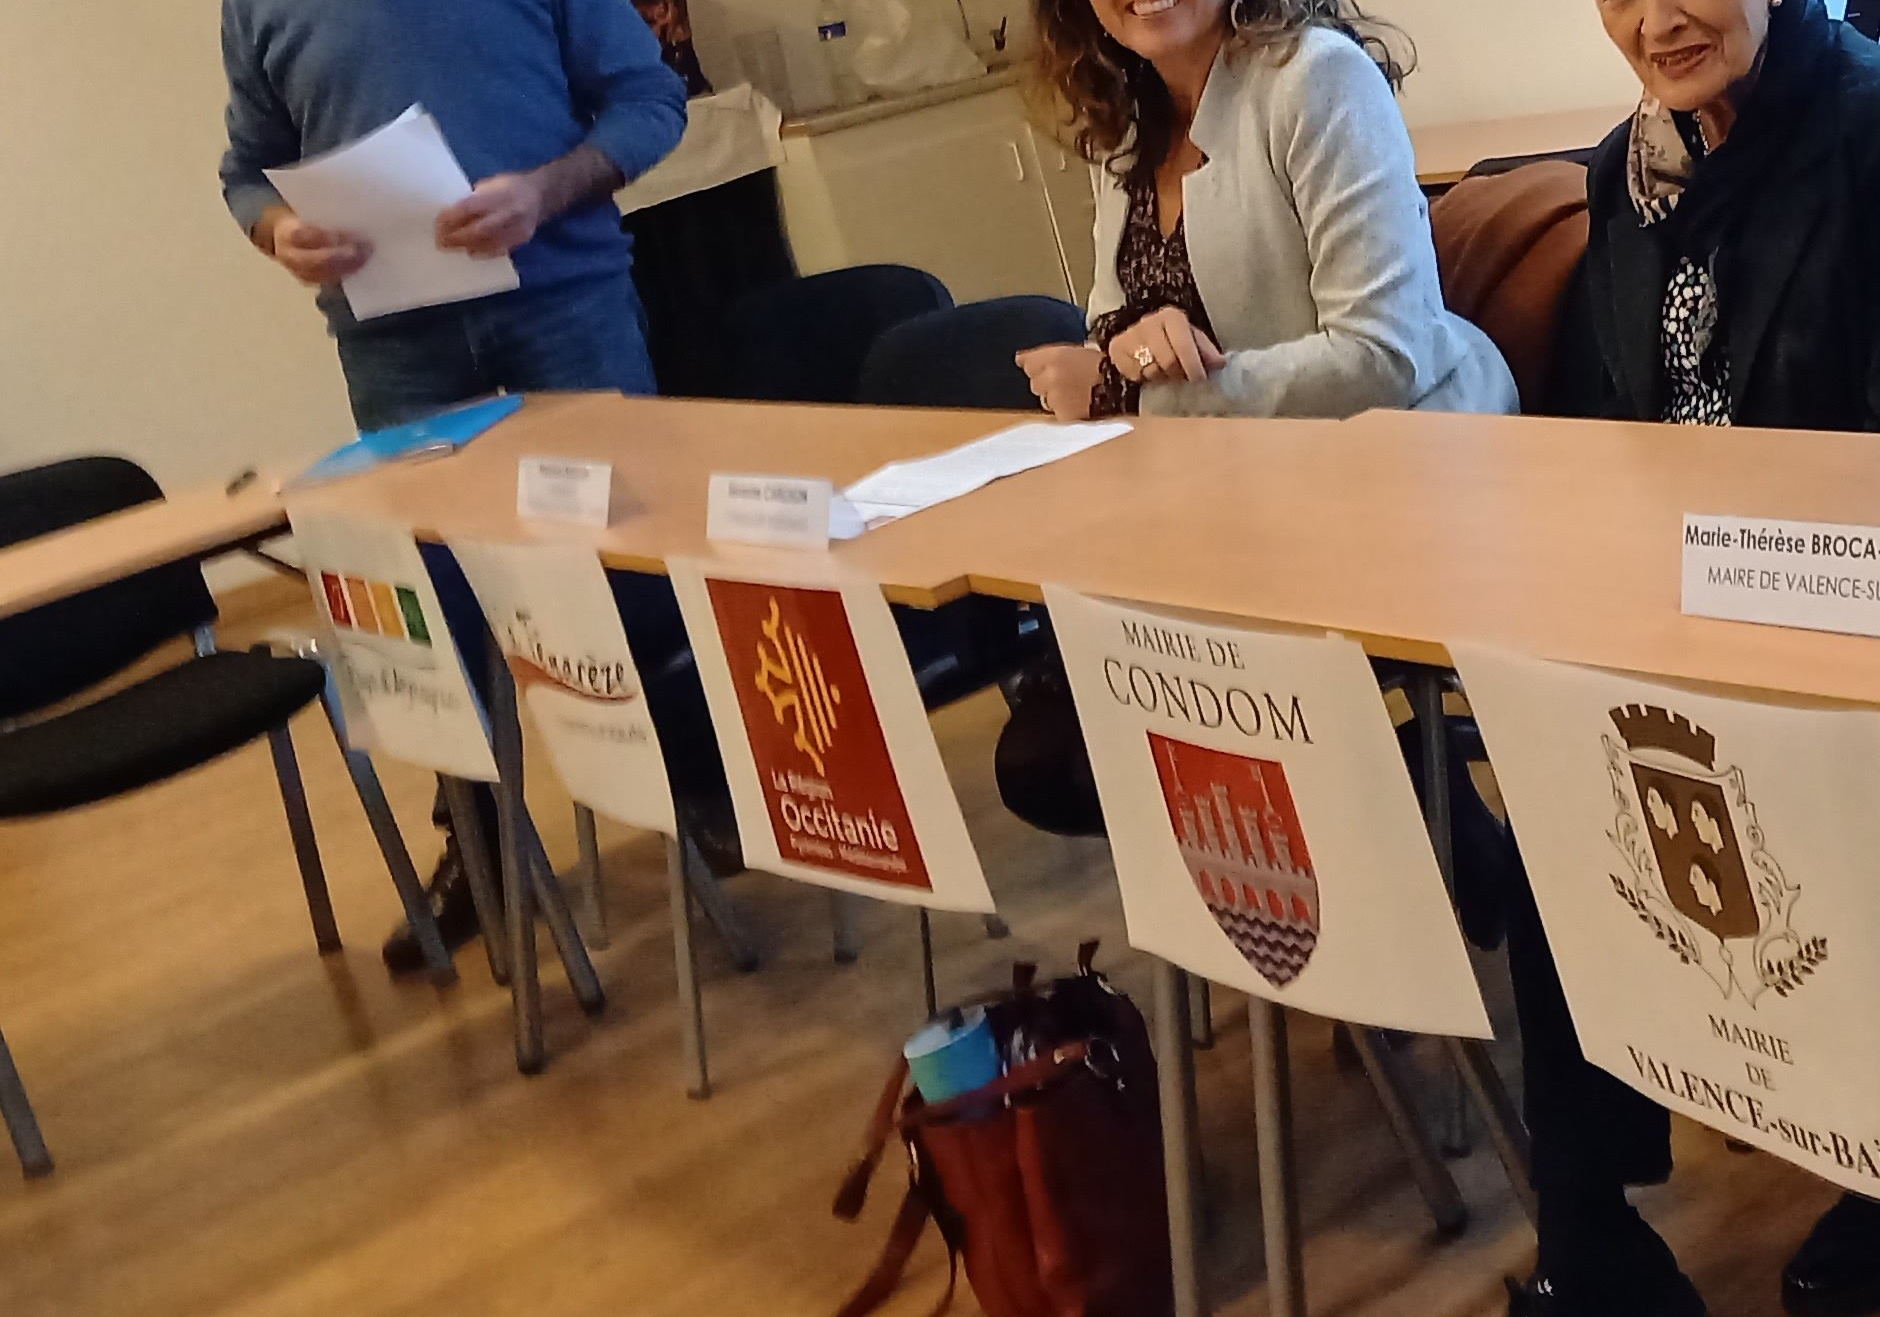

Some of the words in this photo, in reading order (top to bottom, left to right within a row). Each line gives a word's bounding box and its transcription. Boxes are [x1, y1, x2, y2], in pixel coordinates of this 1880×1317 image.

[1684, 525, 1806, 554] Marie-Thérèse
[1707, 566, 1756, 589] MAIRE
[1759, 570, 1780, 591] DE
[1121, 619, 1201, 663] MAIRIE
[1206, 637, 1246, 670] DE
[1103, 656, 1315, 745] CONDOM
[780, 793, 899, 852] Occitanie
[1707, 1012, 1795, 1065] MAIRIE
[1745, 1061, 1778, 1092] DE
